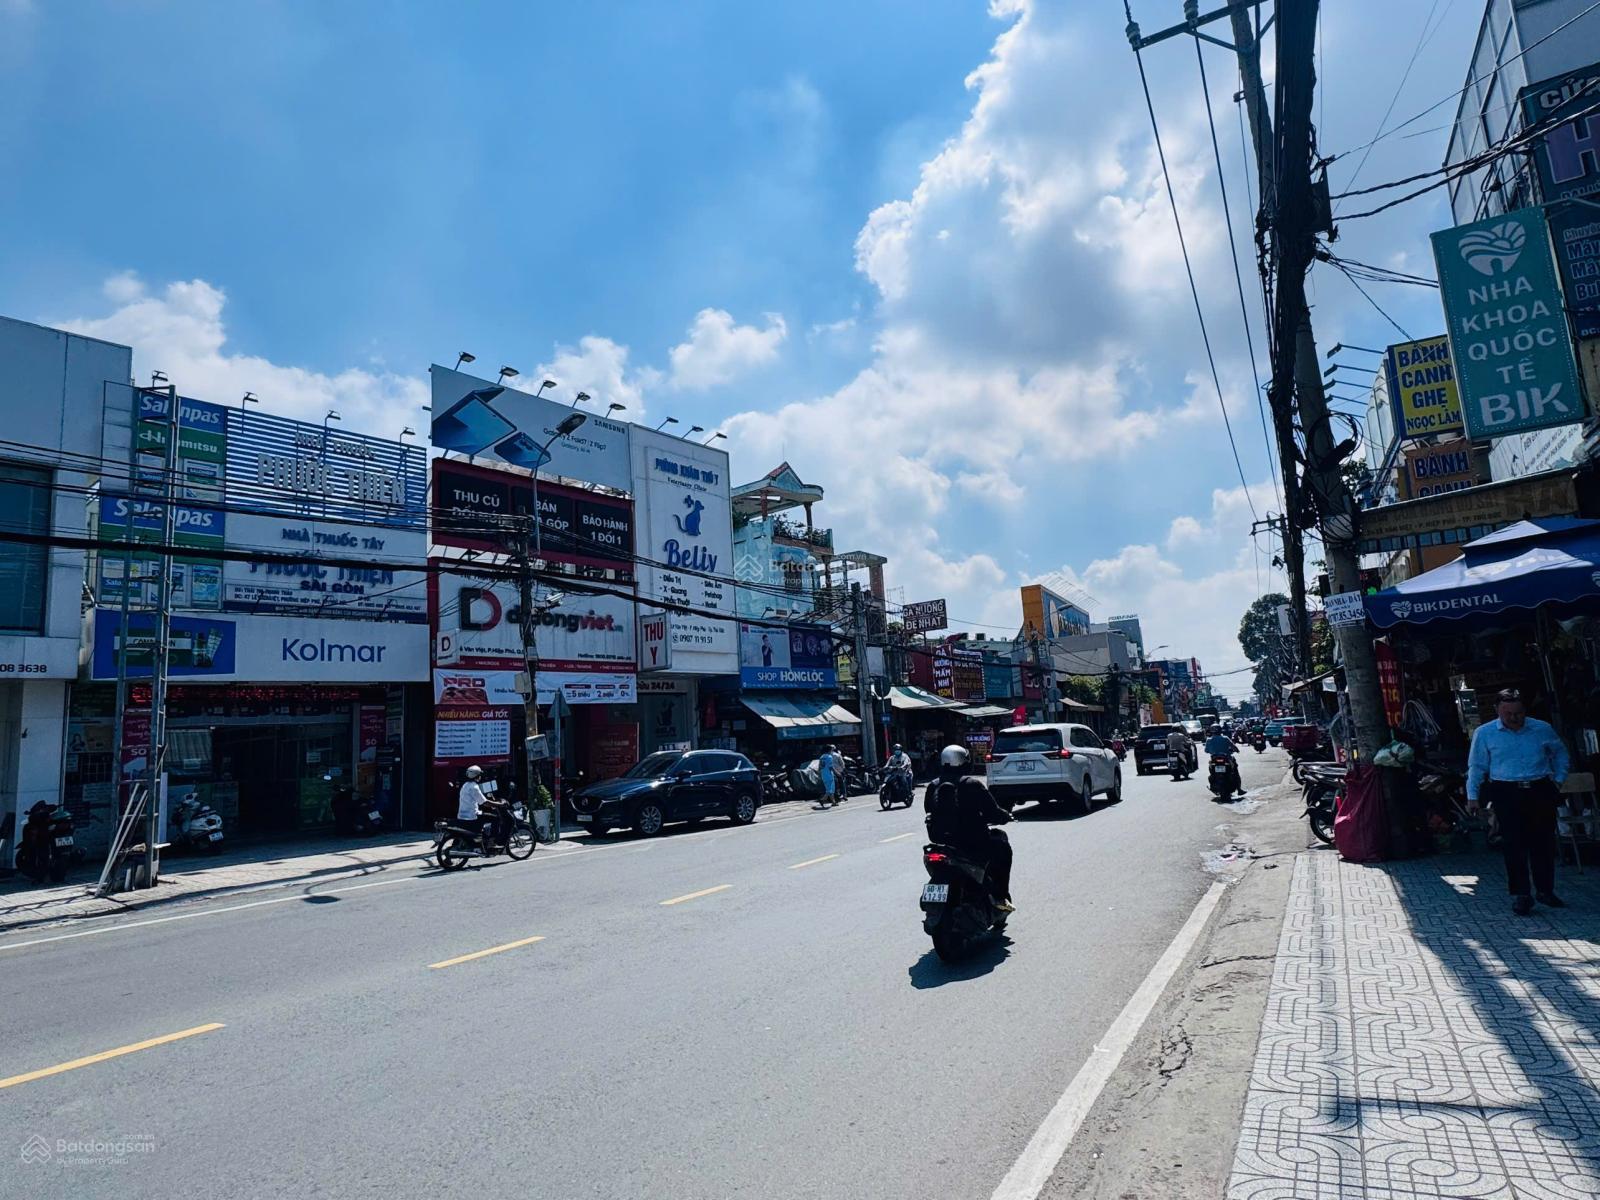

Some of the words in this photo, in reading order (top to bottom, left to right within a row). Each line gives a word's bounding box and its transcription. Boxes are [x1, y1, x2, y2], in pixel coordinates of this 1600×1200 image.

[1468, 276, 1534, 305] NHA
[1462, 300, 1550, 334] KHOA
[1468, 325, 1557, 361] QUỐC
[1401, 365, 1453, 389] CANH
[1496, 354, 1537, 384] TẾ
[141, 396, 220, 424] Salnpas
[1479, 382, 1569, 427] BIK
[594, 419, 626, 434] SAMSUNG
[1414, 452, 1470, 479] BÁNH
[714, 473, 719, 486] Y
[453, 488, 480, 504] THU
[482, 494, 500, 508] CŨ
[113, 499, 213, 527] Salopas
[546, 516, 569, 530] GÓP
[282, 528, 310, 543] NHÀ
[314, 531, 358, 549] THUỐC
[361, 537, 386, 550] TÂY
[591, 531, 596, 541] 1
[617, 536, 622, 545] 1
[300, 579, 327, 592] SÀI
[332, 582, 365, 595] GÒN
[1413, 601, 1439, 613] BIK
[1438, 593, 1504, 611] DENTAL
[643, 617, 664, 642] THÚ
[282, 638, 387, 663] Kolmar
[650, 646, 658, 666] Y
[18, 664, 47, 673] 3638
[757, 672, 778, 681] SHOP
[443, 677, 486, 688] PRO
